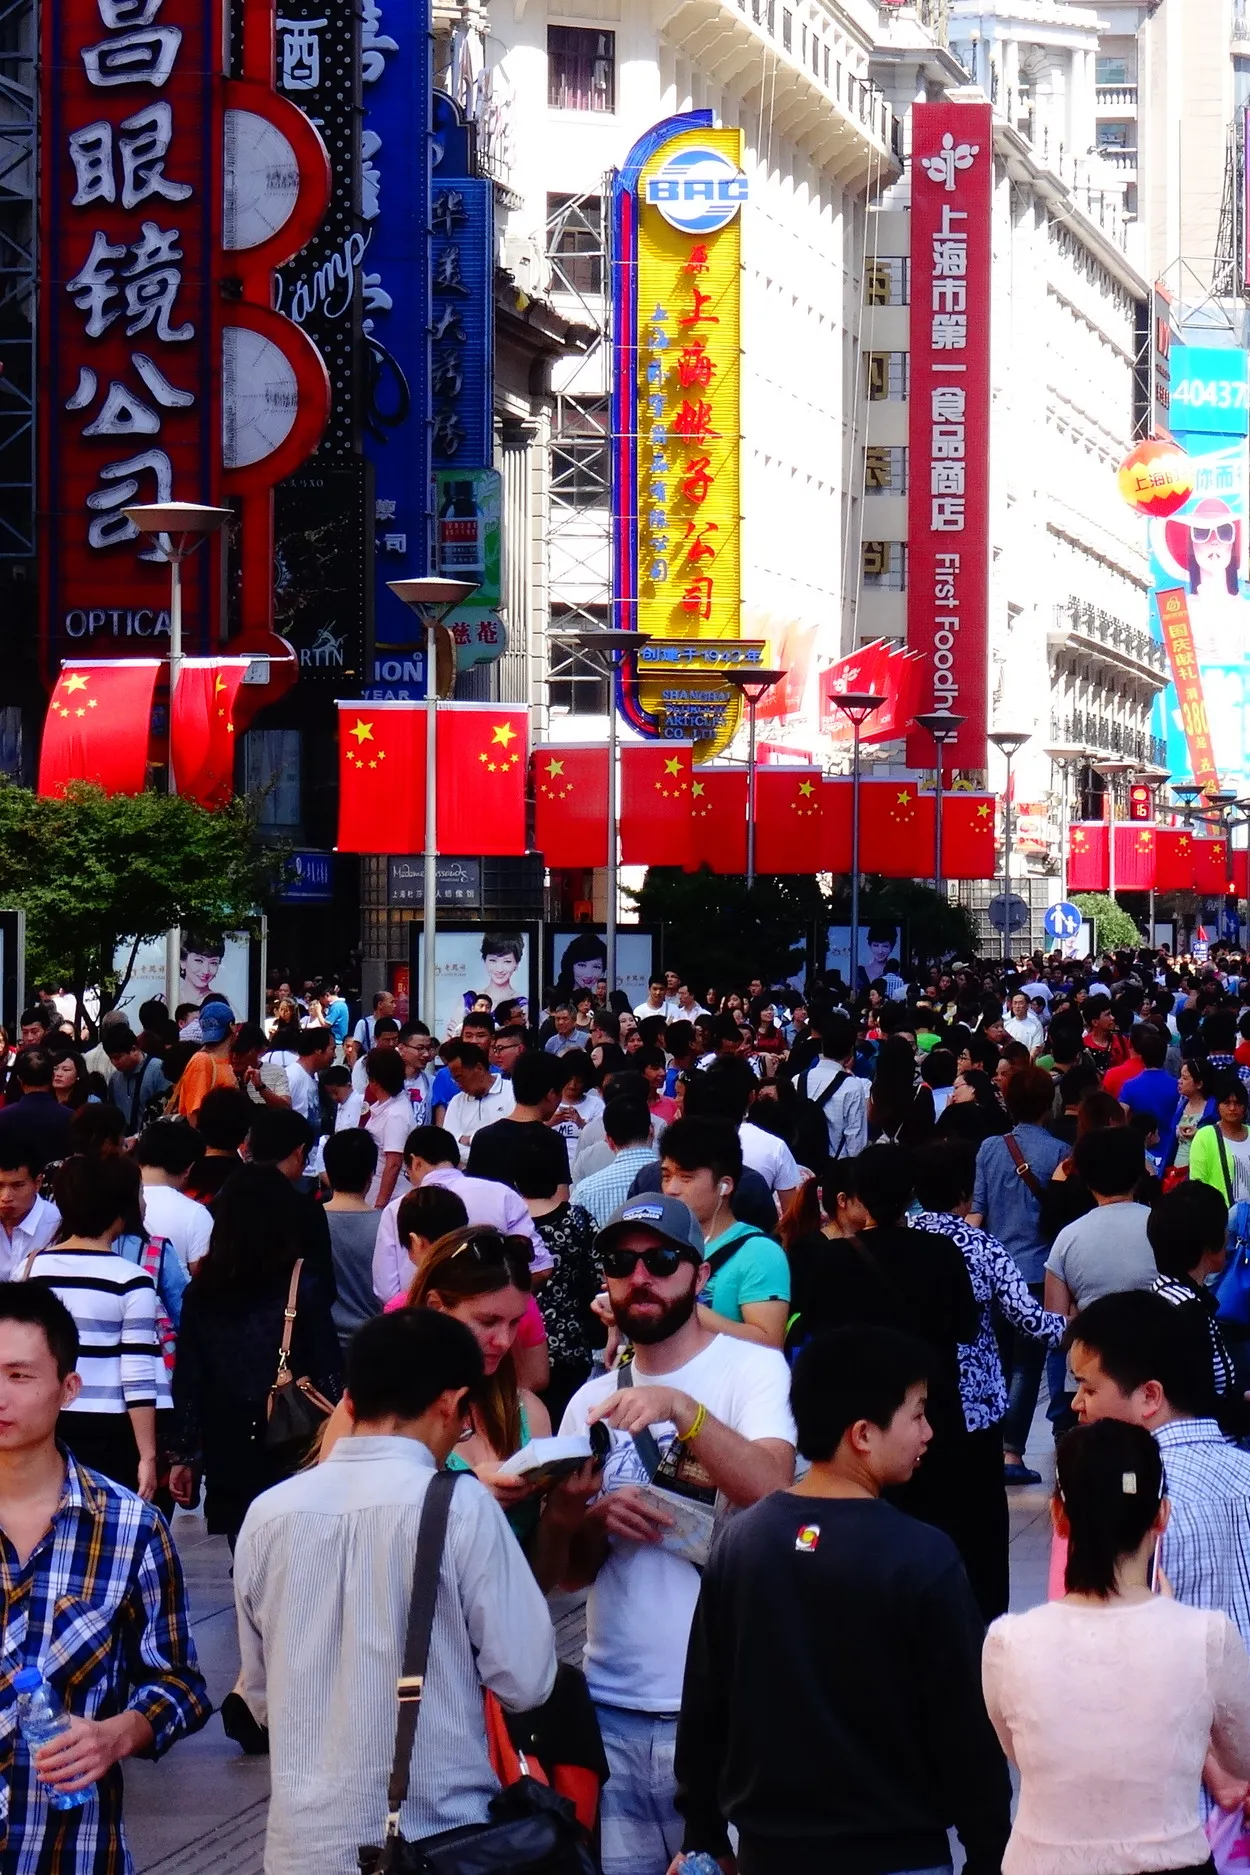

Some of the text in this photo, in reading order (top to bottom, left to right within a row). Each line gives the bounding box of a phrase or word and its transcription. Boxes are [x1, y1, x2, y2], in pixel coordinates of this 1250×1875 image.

[649, 180, 749, 201] BAC
[930, 204, 968, 532] 上海市第一食品商店
[934, 553, 960, 608] First
[65, 609, 190, 638] OPTICA
[300, 649, 344, 667] RTIN
[374, 661, 423, 683] ION
[435, 862, 470, 883] ssauds
[392, 889, 475, 899] 上海杜莎人蜡像馆
